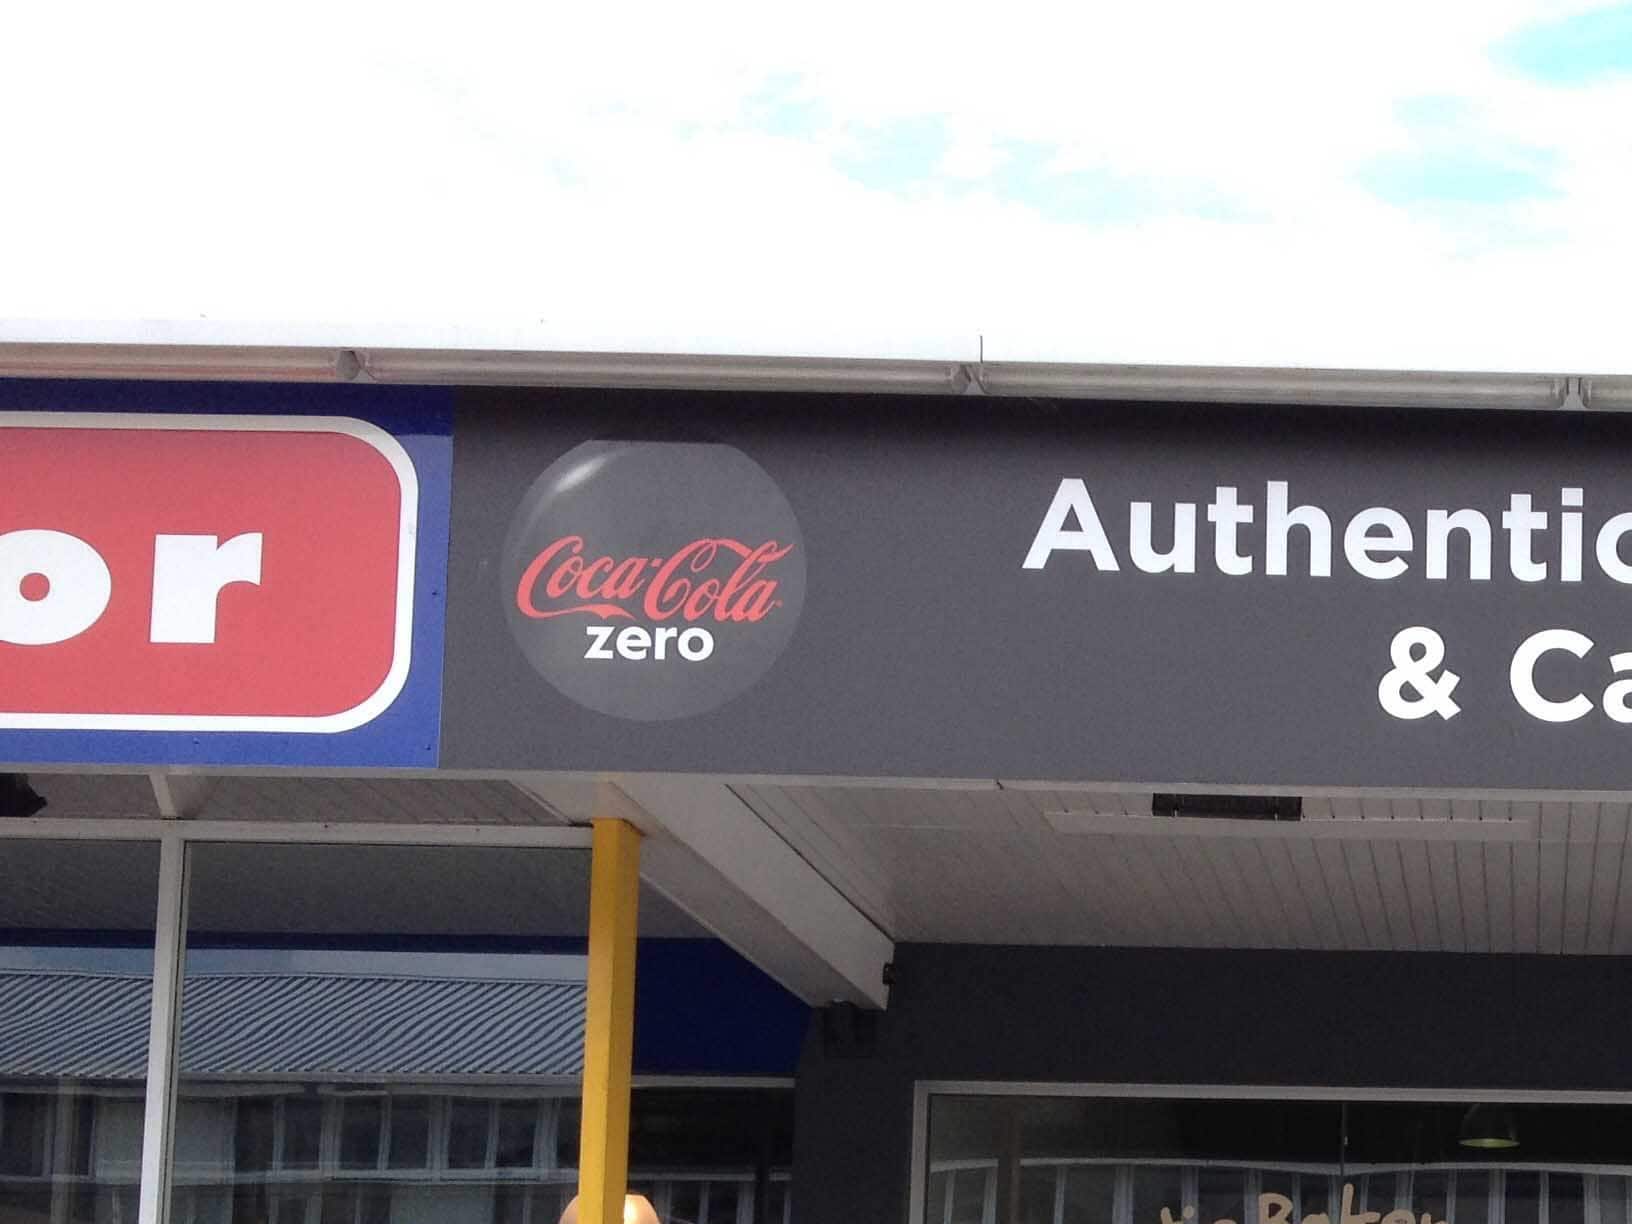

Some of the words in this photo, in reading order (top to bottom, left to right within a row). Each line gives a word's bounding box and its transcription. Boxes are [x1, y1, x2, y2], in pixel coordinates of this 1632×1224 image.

[516, 535, 795, 623] Coca-Cola
[584, 622, 715, 661] zero
[1378, 626, 1461, 720] &
